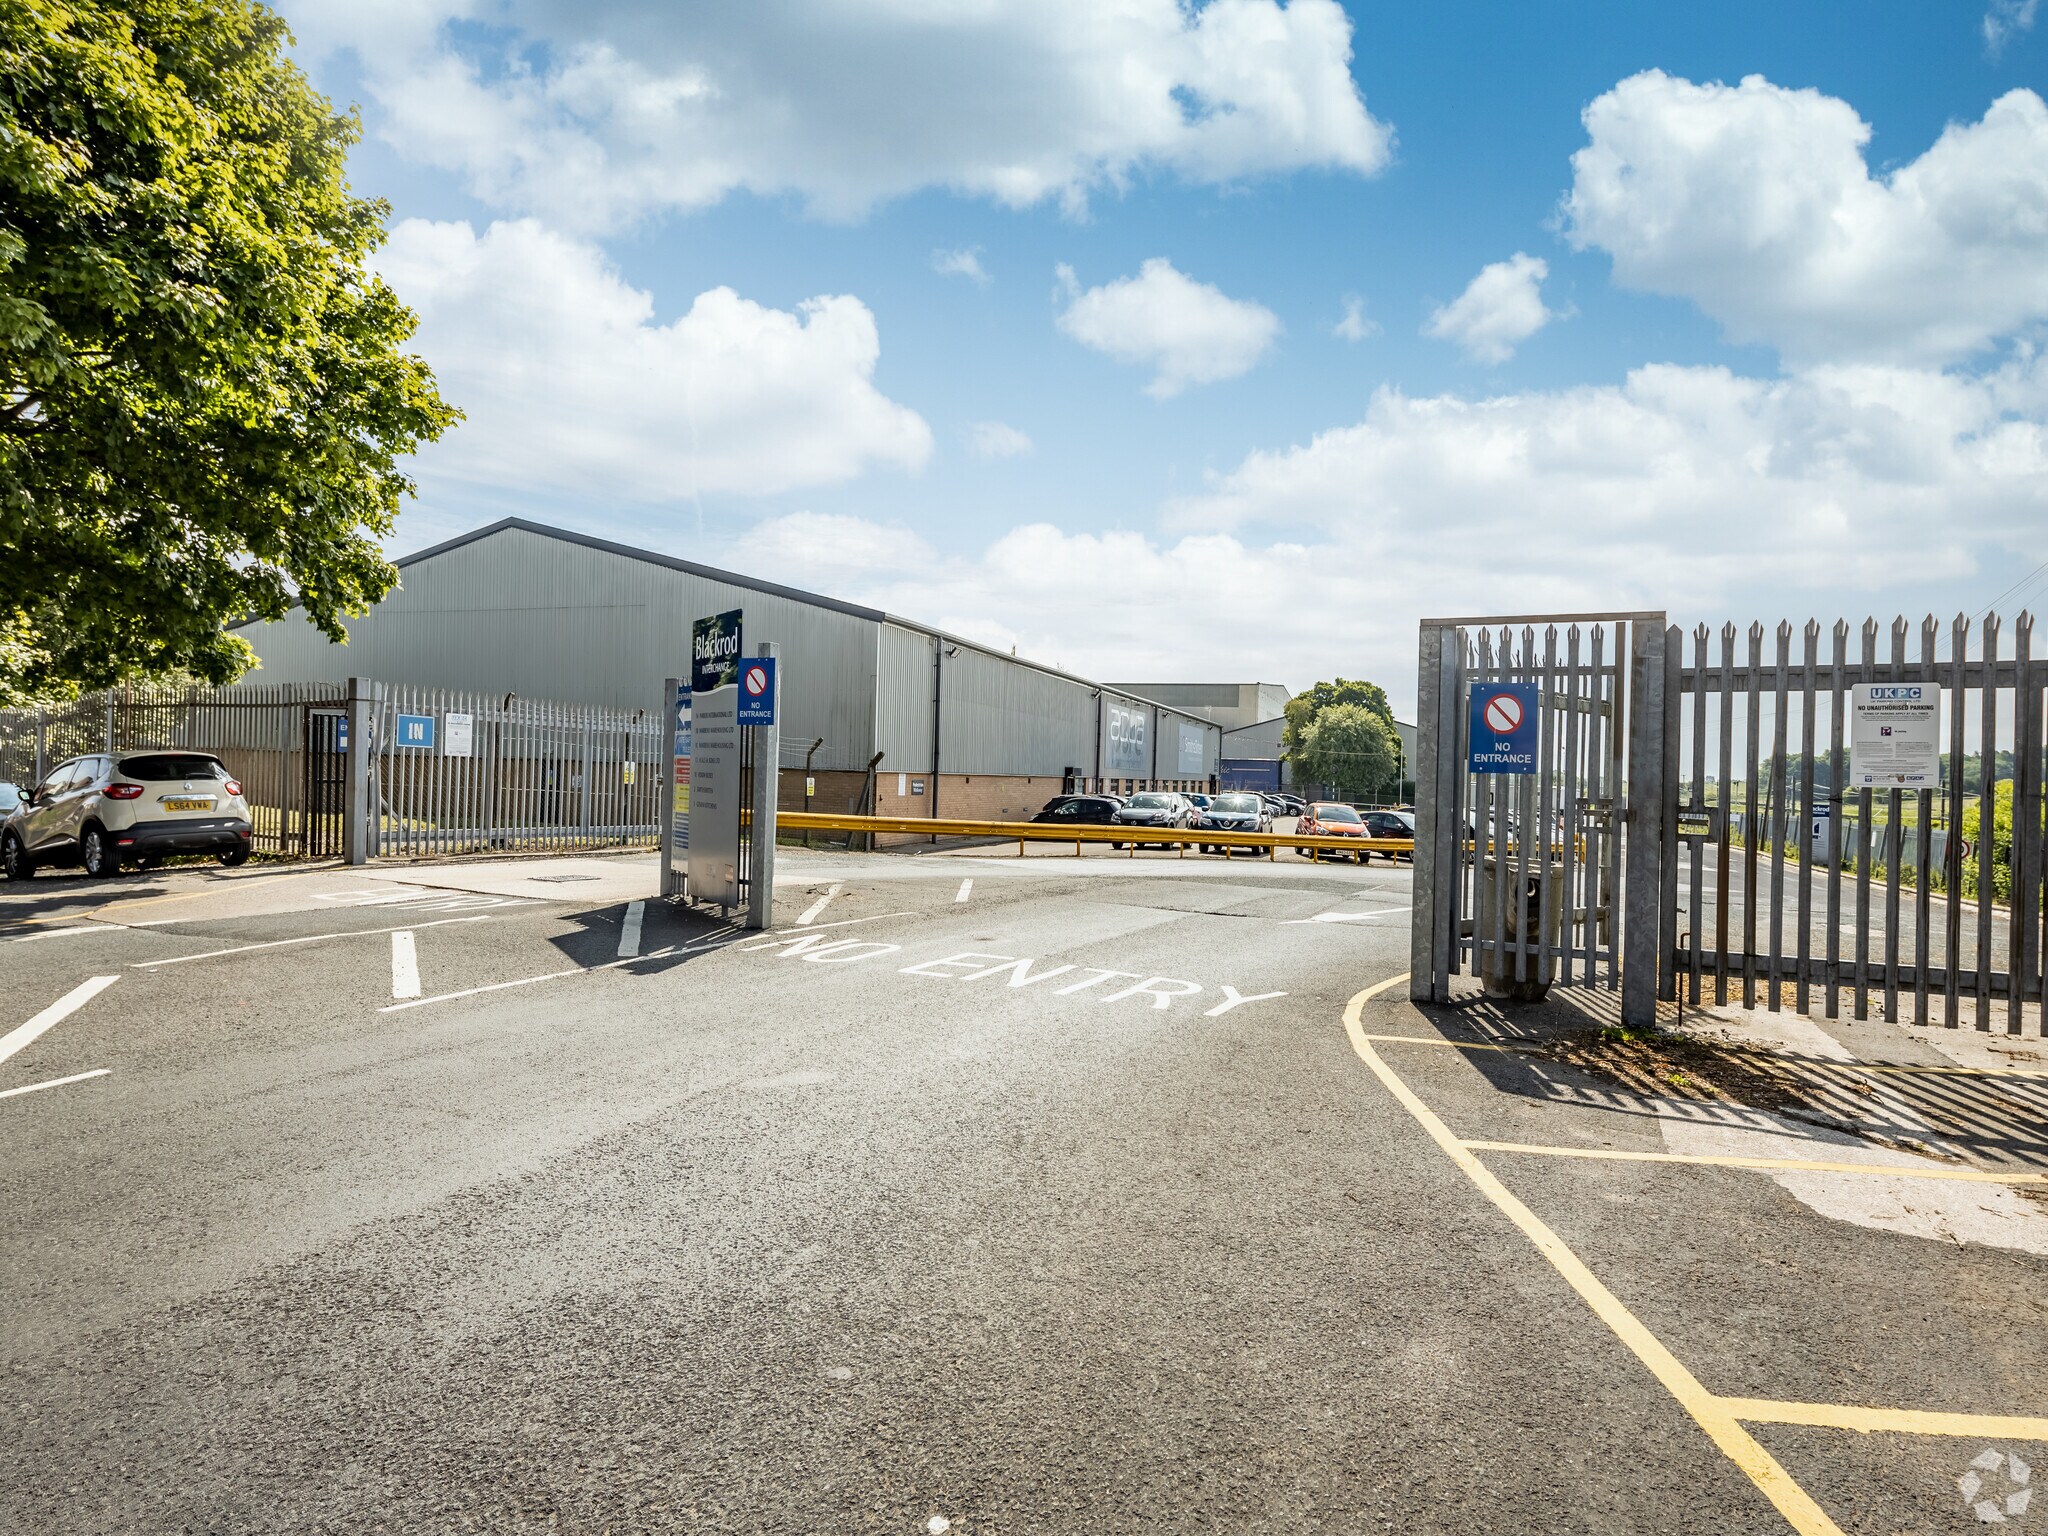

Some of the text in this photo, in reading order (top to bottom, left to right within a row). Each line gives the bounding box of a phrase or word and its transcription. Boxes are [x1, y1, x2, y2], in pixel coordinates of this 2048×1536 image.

[695, 626, 738, 661] Blackrod
[701, 661, 731, 675] INTERCHANGE
[1871, 688, 1921, 699] UKPC
[739, 710, 772, 718] ENTRANCE
[408, 722, 424, 740] IN
[1495, 742, 1511, 752] NO
[1473, 753, 1532, 764] ENTRANCE
[168, 802, 189, 810] LS64
[740, 933, 1290, 1017] NO ENTRY
